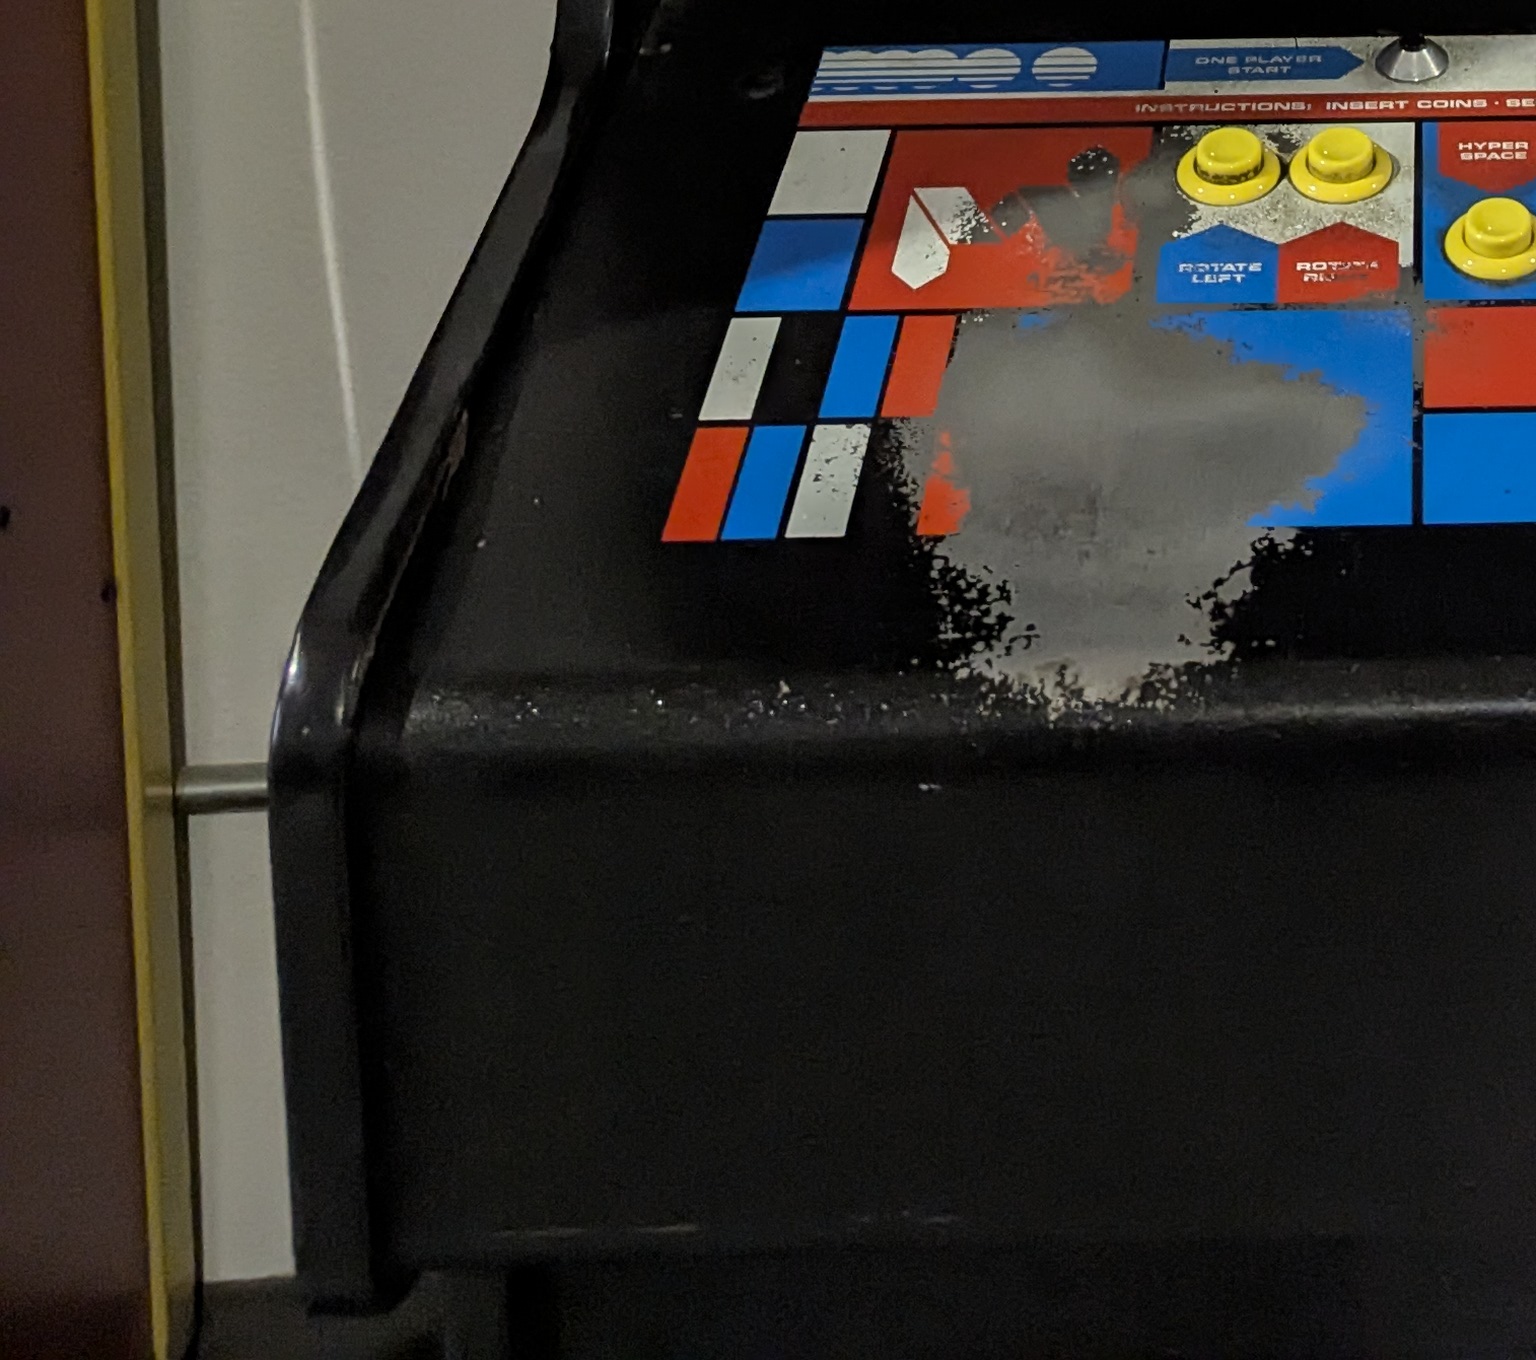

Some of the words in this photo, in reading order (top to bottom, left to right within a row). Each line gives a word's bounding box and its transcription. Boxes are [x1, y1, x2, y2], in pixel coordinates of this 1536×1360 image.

[1195, 56, 1238, 65] ONE
[1245, 55, 1322, 64] PLAYER
[1228, 66, 1291, 75] START
[1326, 100, 1409, 110] INSERT
[1416, 98, 1488, 109] COINS
[1458, 141, 1529, 150] HYPER
[1460, 151, 1527, 161] SPACE
[1178, 262, 1262, 273] ROTATE
[1191, 274, 1246, 283] LEFT
